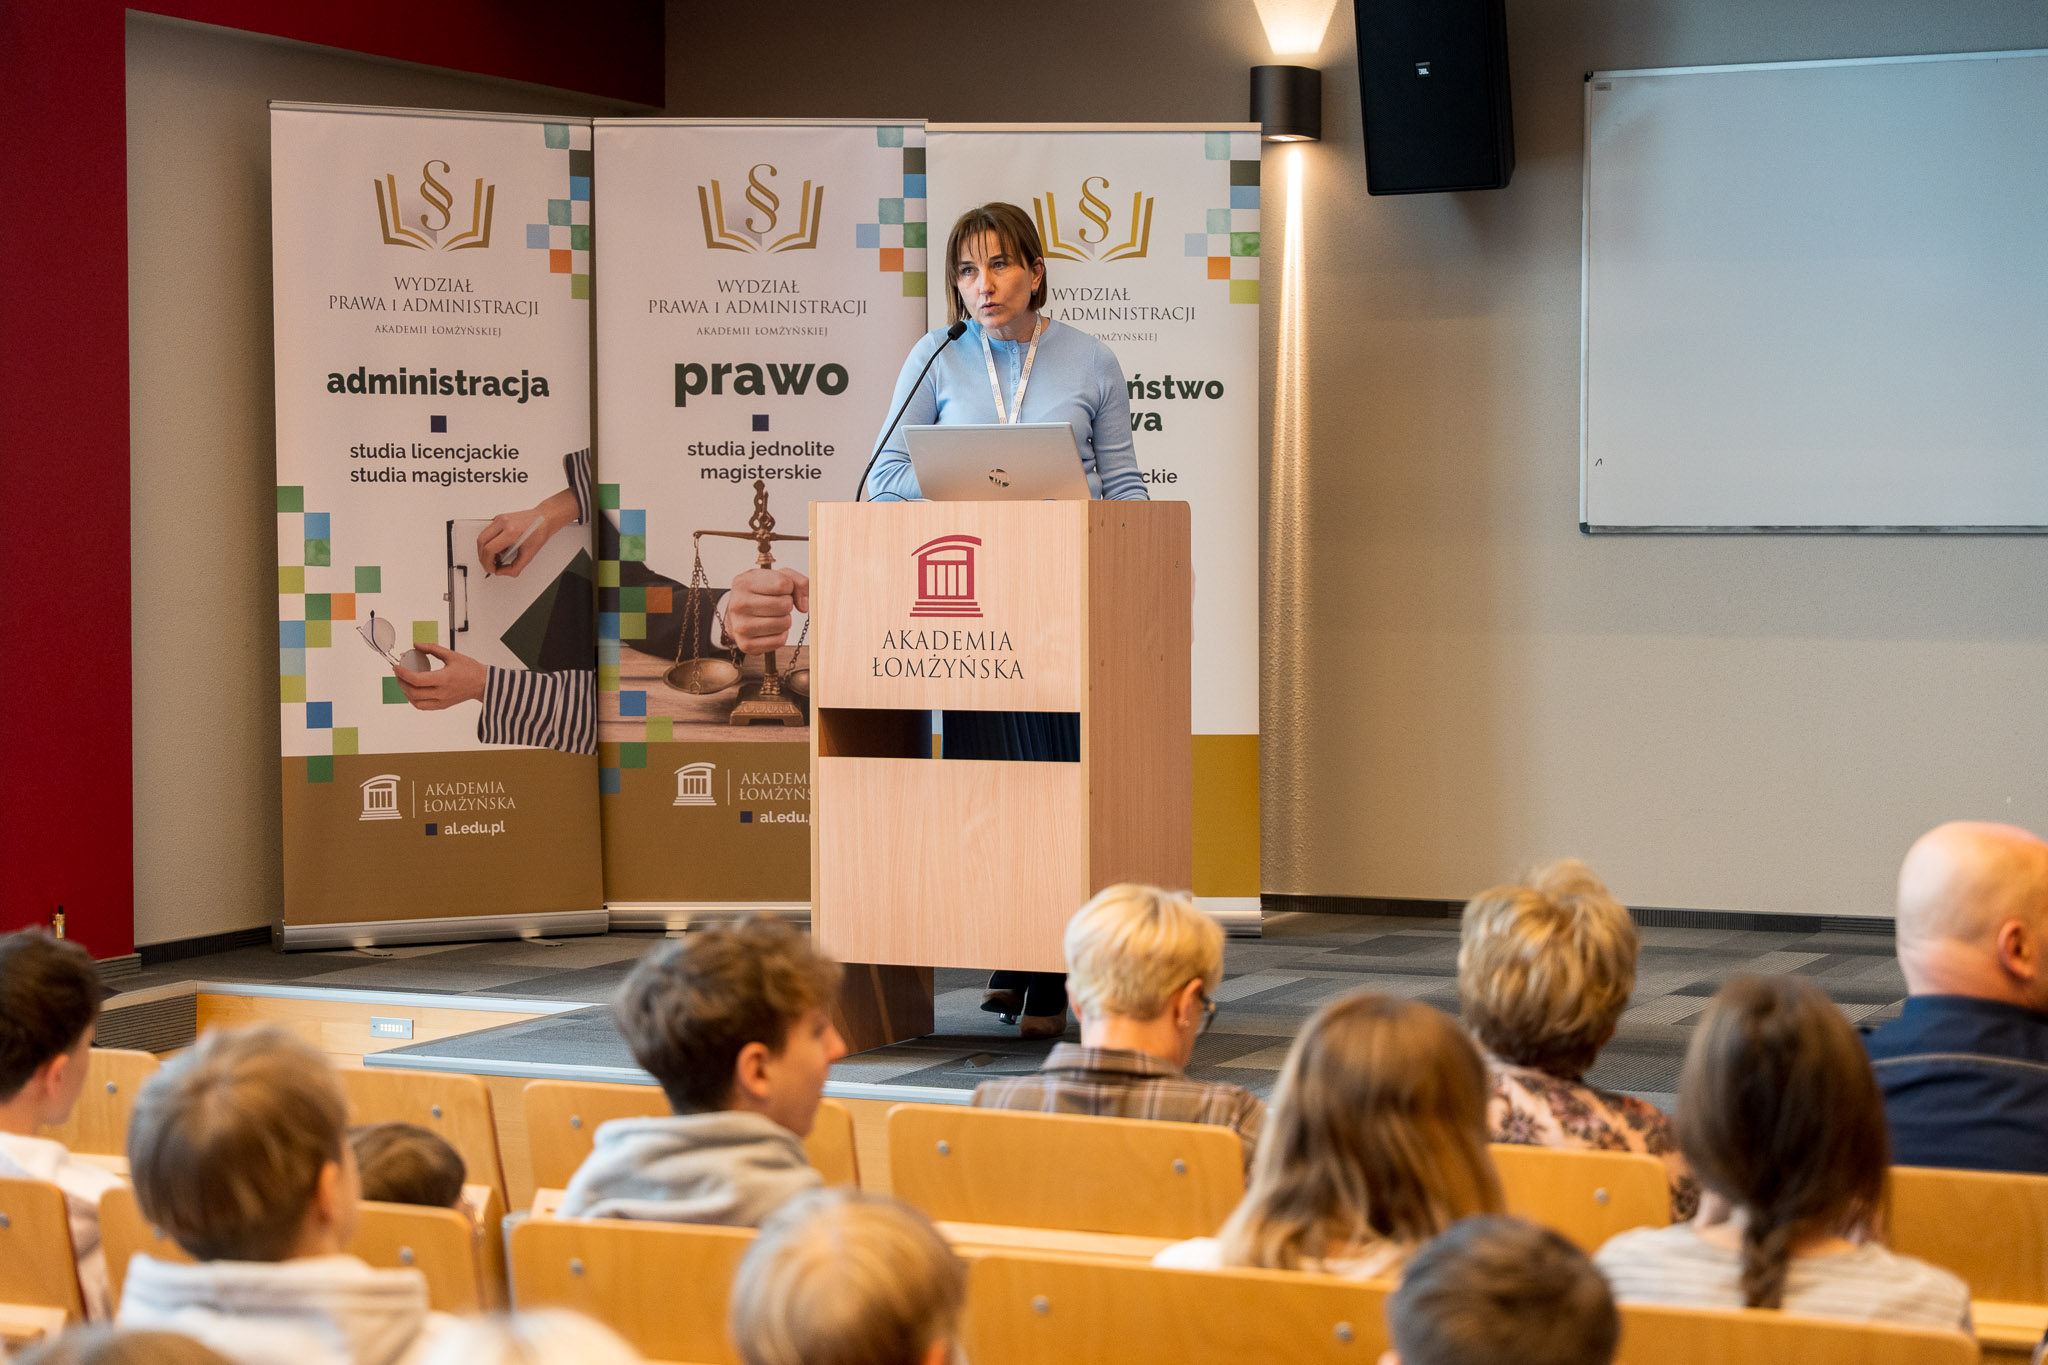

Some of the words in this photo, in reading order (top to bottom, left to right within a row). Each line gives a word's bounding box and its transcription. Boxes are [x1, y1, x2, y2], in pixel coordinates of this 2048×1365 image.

[394, 276, 474, 293] WYDZIAŁ
[717, 279, 800, 294] WYDZIAŁ
[1051, 287, 1131, 301] WYDZIAŁ
[329, 294, 387, 311] PRAWA
[402, 298, 539, 318] ADMINISTRACJI
[648, 299, 709, 314] PRAWA
[726, 299, 867, 317] ADMINISTRACJI
[1059, 306, 1195, 323] ADMINISTRACJI
[374, 324, 428, 335] AKADEMII
[431, 324, 502, 338] ŁOMŻYŃSKIEJ
[696, 326, 750, 336] AKADEMII
[755, 325, 828, 337] ŁOMŻYŃSKIEJ
[1090, 332, 1158, 342] OMŻYŃSKIEJ
[326, 366, 550, 404] administracja
[674, 362, 849, 408] prawo
[350, 443, 406, 460] studia
[411, 444, 520, 463] licencjackie
[687, 441, 746, 457] studia
[748, 441, 835, 460] jednolite
[350, 467, 407, 483] studia
[412, 467, 529, 487] magisterskie
[700, 464, 822, 483] magisterskie
[882, 629, 1014, 651] AKADEMIA
[872, 654, 1025, 680] ŁOMŻYŃSKA
[740, 772, 811, 785] AKADEM
[425, 781, 505, 796] AKADEMIA
[739, 785, 811, 801] ŁOMŻYŃS
[424, 796, 516, 813] ŁOMŻYŃSKA
[760, 810, 811, 826] al.edu.
[444, 820, 505, 837] al.edu.pl
